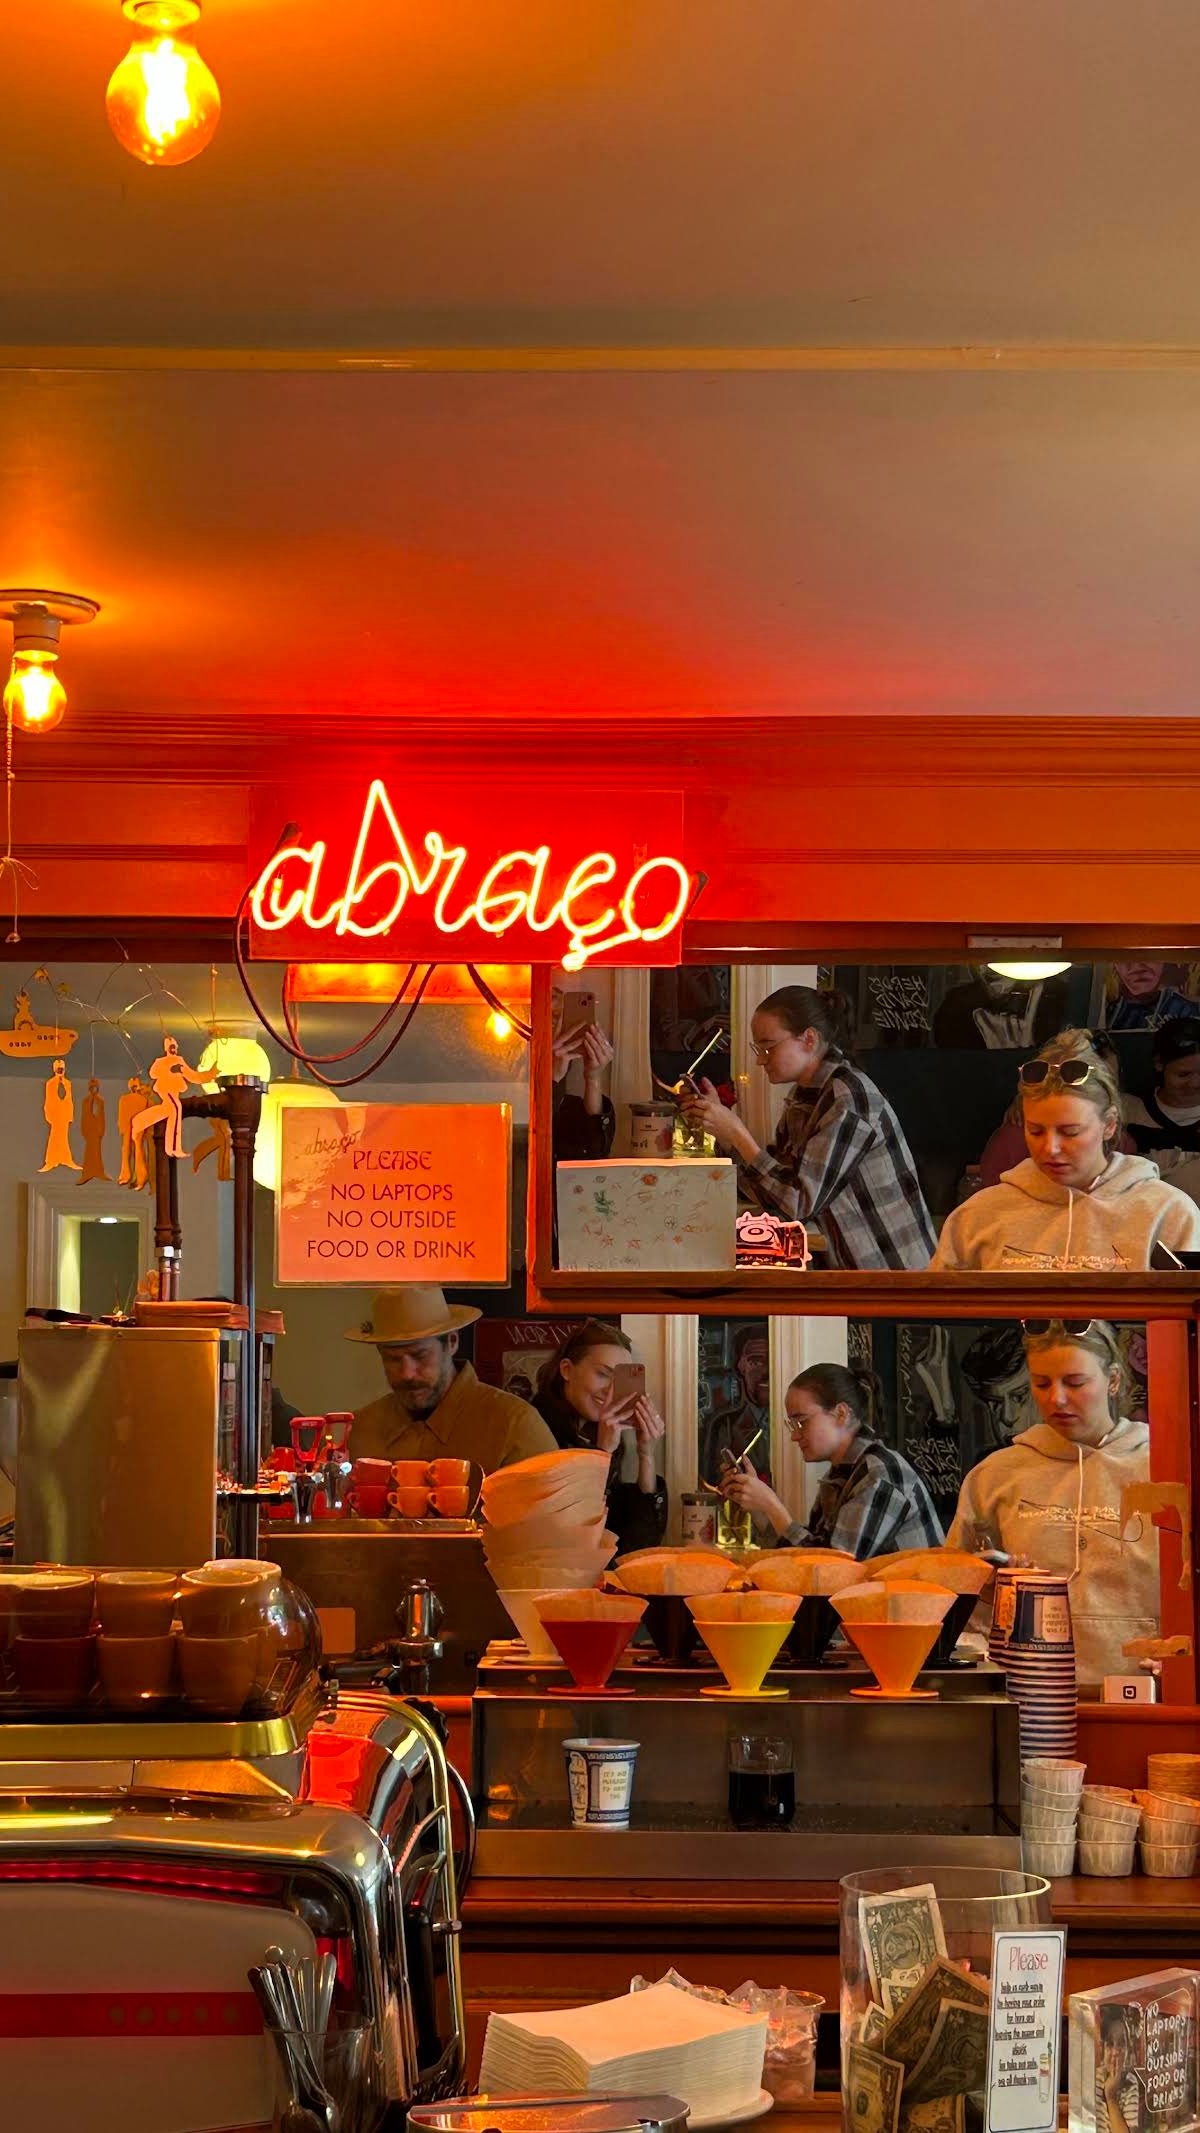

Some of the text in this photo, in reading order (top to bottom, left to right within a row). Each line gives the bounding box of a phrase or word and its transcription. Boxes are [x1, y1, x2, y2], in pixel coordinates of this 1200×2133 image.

[251, 778, 690, 972] abraço
[352, 1150, 433, 1171] PLEASE
[331, 1184, 453, 1201] NO LAPTOPS
[327, 1210, 457, 1228] NO OUTSIDE
[307, 1240, 476, 1259] FOOD OR DRINK
[1009, 1946, 1049, 1971] Please
[1147, 2001, 1159, 2018] NO
[1147, 2038, 1160, 2055] NO
[1147, 2049, 1184, 2072] OUTSIDE
[1147, 2068, 1186, 2092] FOOD OR
[1152, 2085, 1184, 2108] DRINKS
